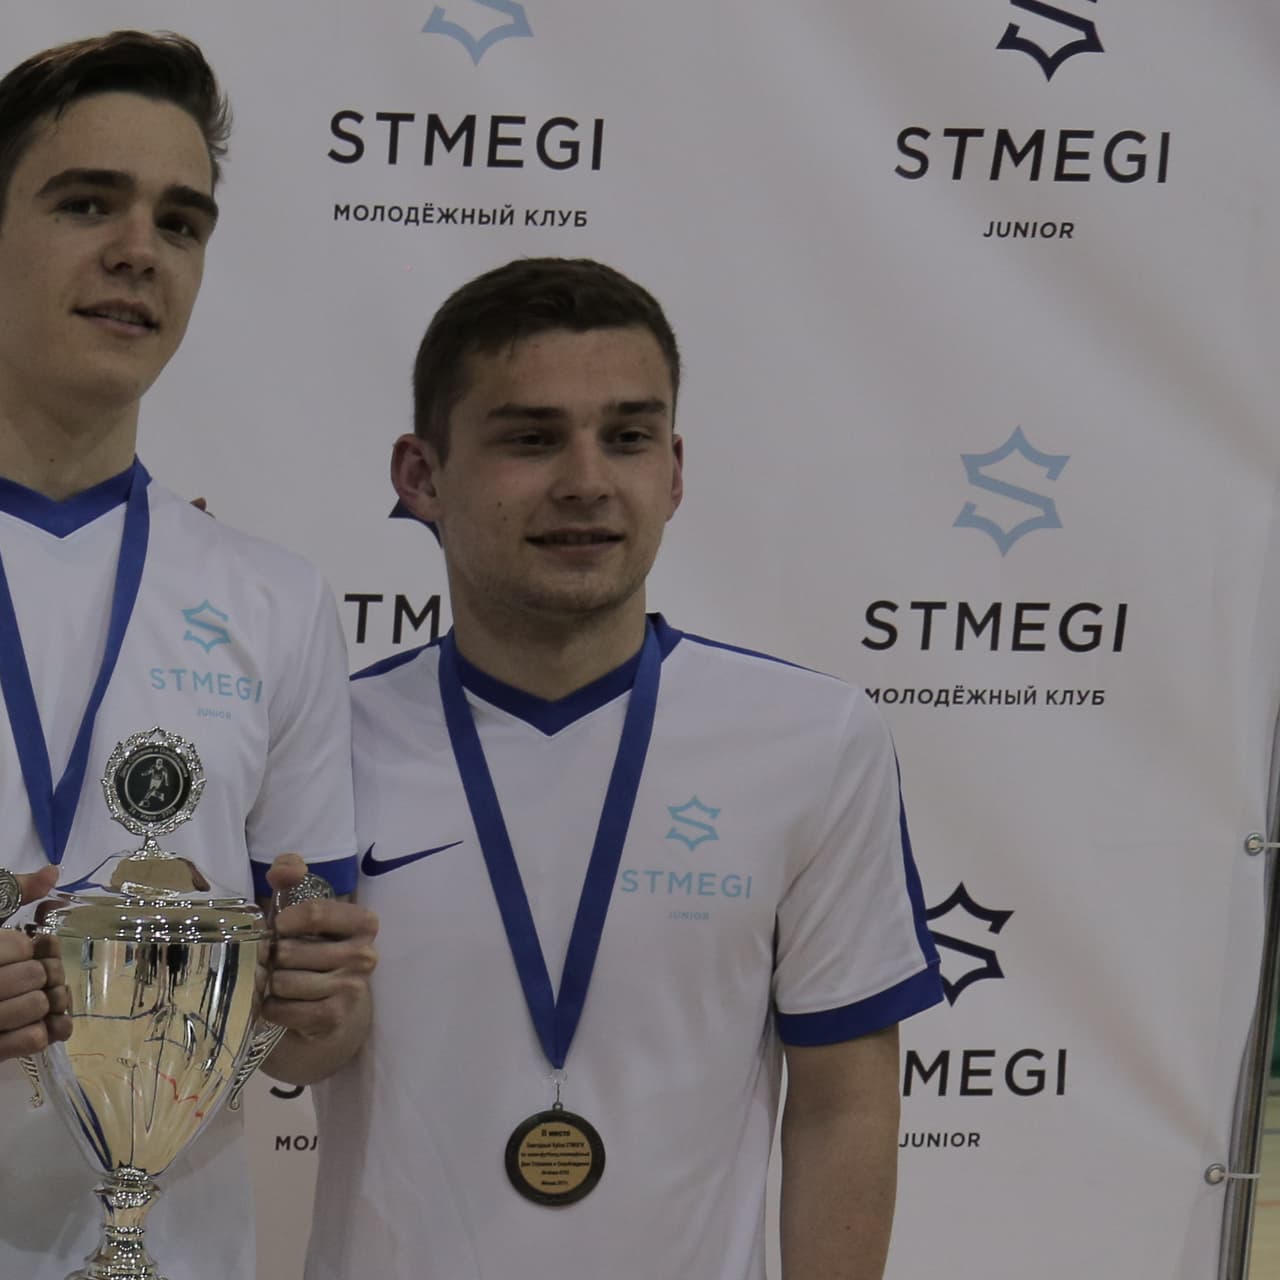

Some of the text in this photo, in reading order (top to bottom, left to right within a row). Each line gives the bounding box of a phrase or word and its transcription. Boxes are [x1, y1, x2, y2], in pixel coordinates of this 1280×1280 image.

[327, 109, 604, 171] STMEGI
[894, 126, 1171, 184] STMEGI
[333, 202, 588, 228] МОЛОДЁЖНЫЙ КЛУБ
[983, 220, 1075, 239] JUNIOR
[861, 600, 1128, 653] STMEGI
[149, 667, 263, 703] STMEGI
[1045, 689, 1105, 706] КЛУБ
[620, 869, 753, 899] STMEGI
[902, 1048, 1067, 1097] MEGI
[900, 1132, 981, 1148] JUNIOR
